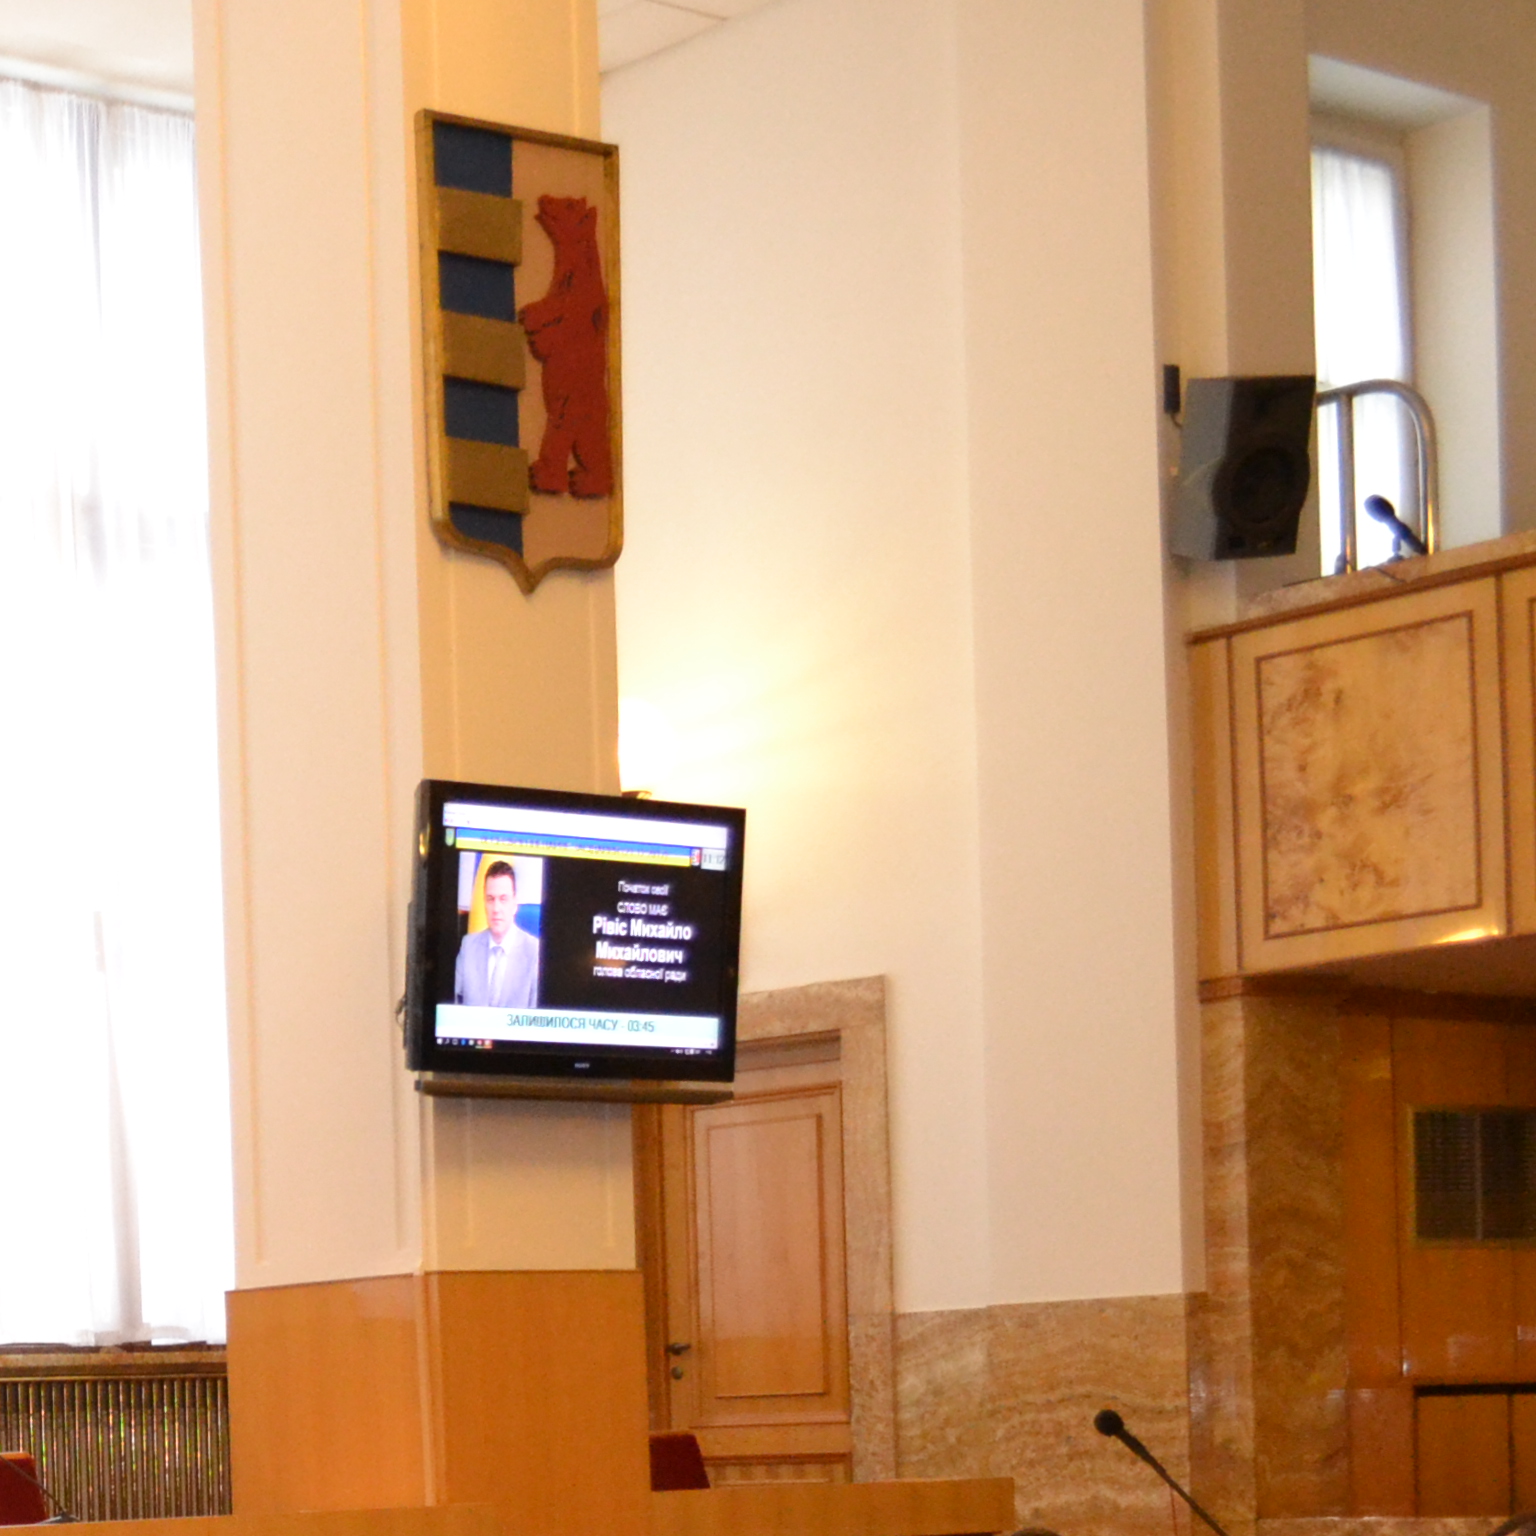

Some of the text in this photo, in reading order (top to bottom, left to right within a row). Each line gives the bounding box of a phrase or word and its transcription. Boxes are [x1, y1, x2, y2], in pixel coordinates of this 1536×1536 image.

[592, 915, 692, 940] Рівіс Михайло
[595, 940, 683, 964] Михайлович
[507, 1013, 585, 1029] ЗАЛИШИЛОСЯ
[589, 1018, 618, 1031] ЧАСУ
[627, 1019, 655, 1032] 03:45
